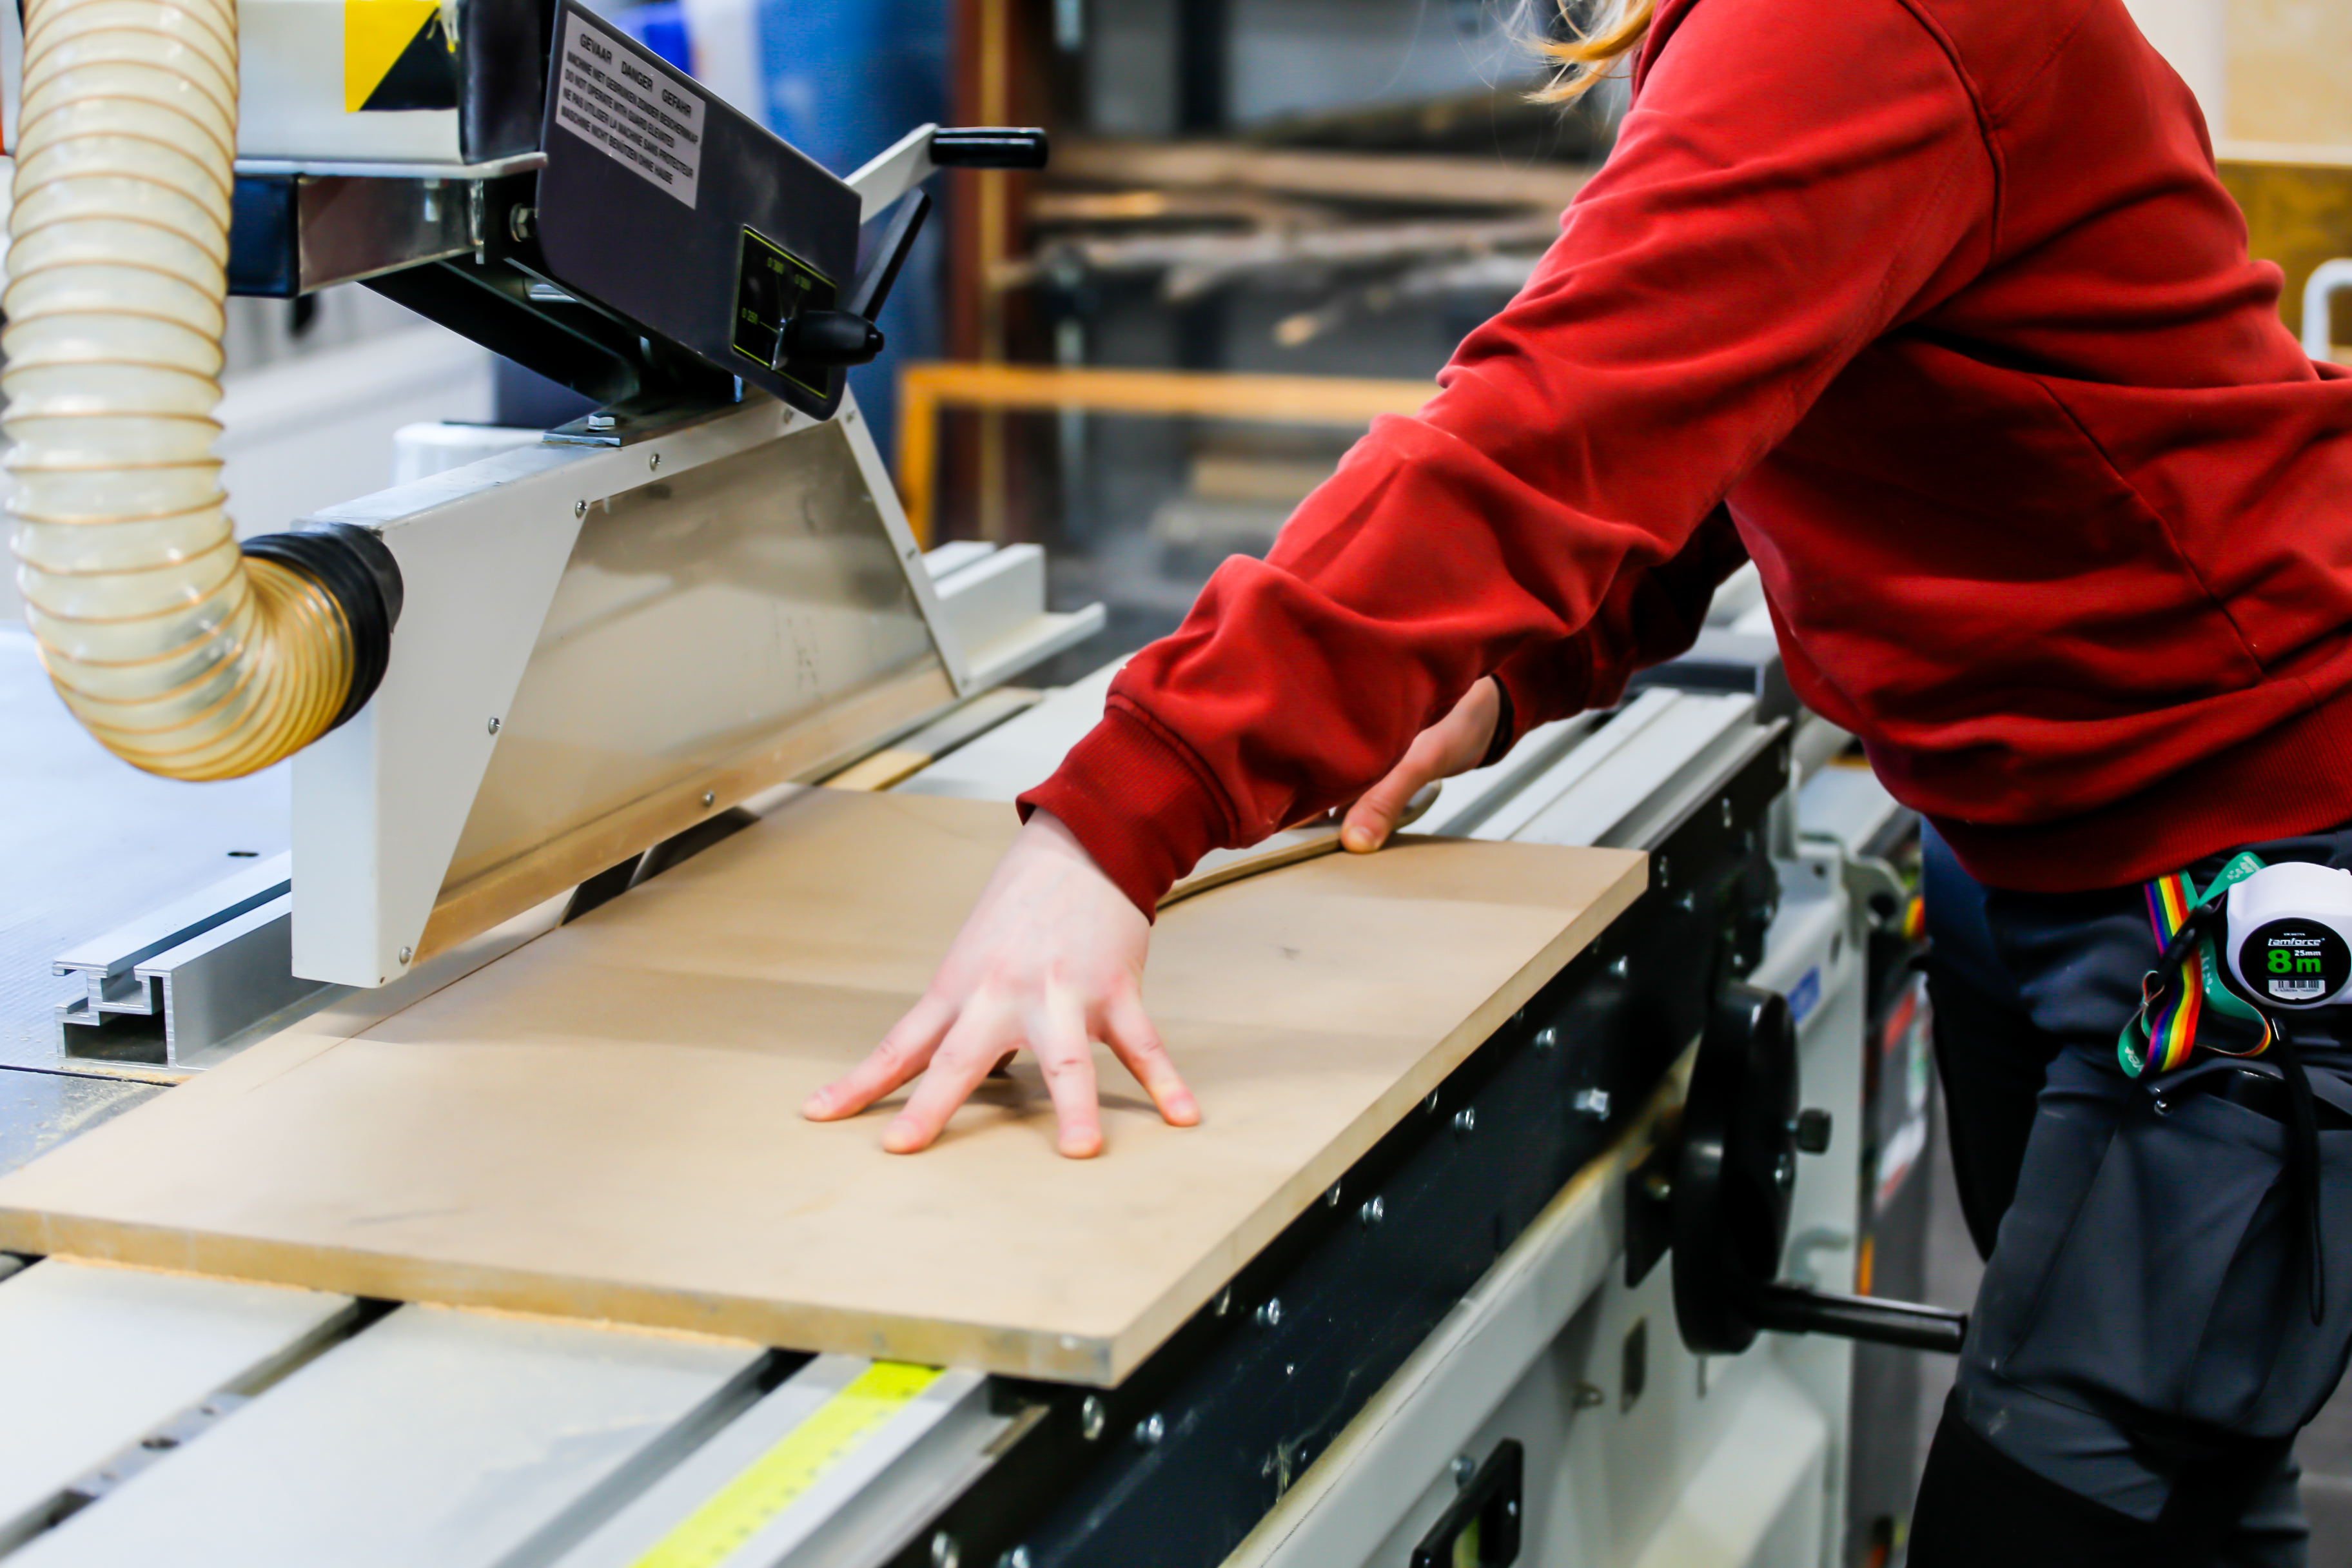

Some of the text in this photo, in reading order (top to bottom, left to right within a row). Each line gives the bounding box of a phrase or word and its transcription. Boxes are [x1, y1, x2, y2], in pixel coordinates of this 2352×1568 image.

[565, 69, 574, 83] DO
[574, 75, 586, 91] NOT
[587, 84, 612, 108] OPERATE
[627, 110, 647, 130] GUARD
[647, 124, 674, 148] ELEVATED
[567, 51, 591, 75] MACHINE
[605, 77, 636, 104] GEBRUIKEN
[637, 98, 659, 120] ZONDER
[579, 34, 691, 118] GEVAAR DANGER GEFAHR
[561, 106, 590, 132] MASCHINE
[638, 155, 653, 172] OHNE
[654, 164, 672, 184] HAUBE
[563, 88, 693, 179] NE PAS UTILISER LA MACHINE SANS PROTECTEUR
[2268, 949, 2321, 973] 8 m
